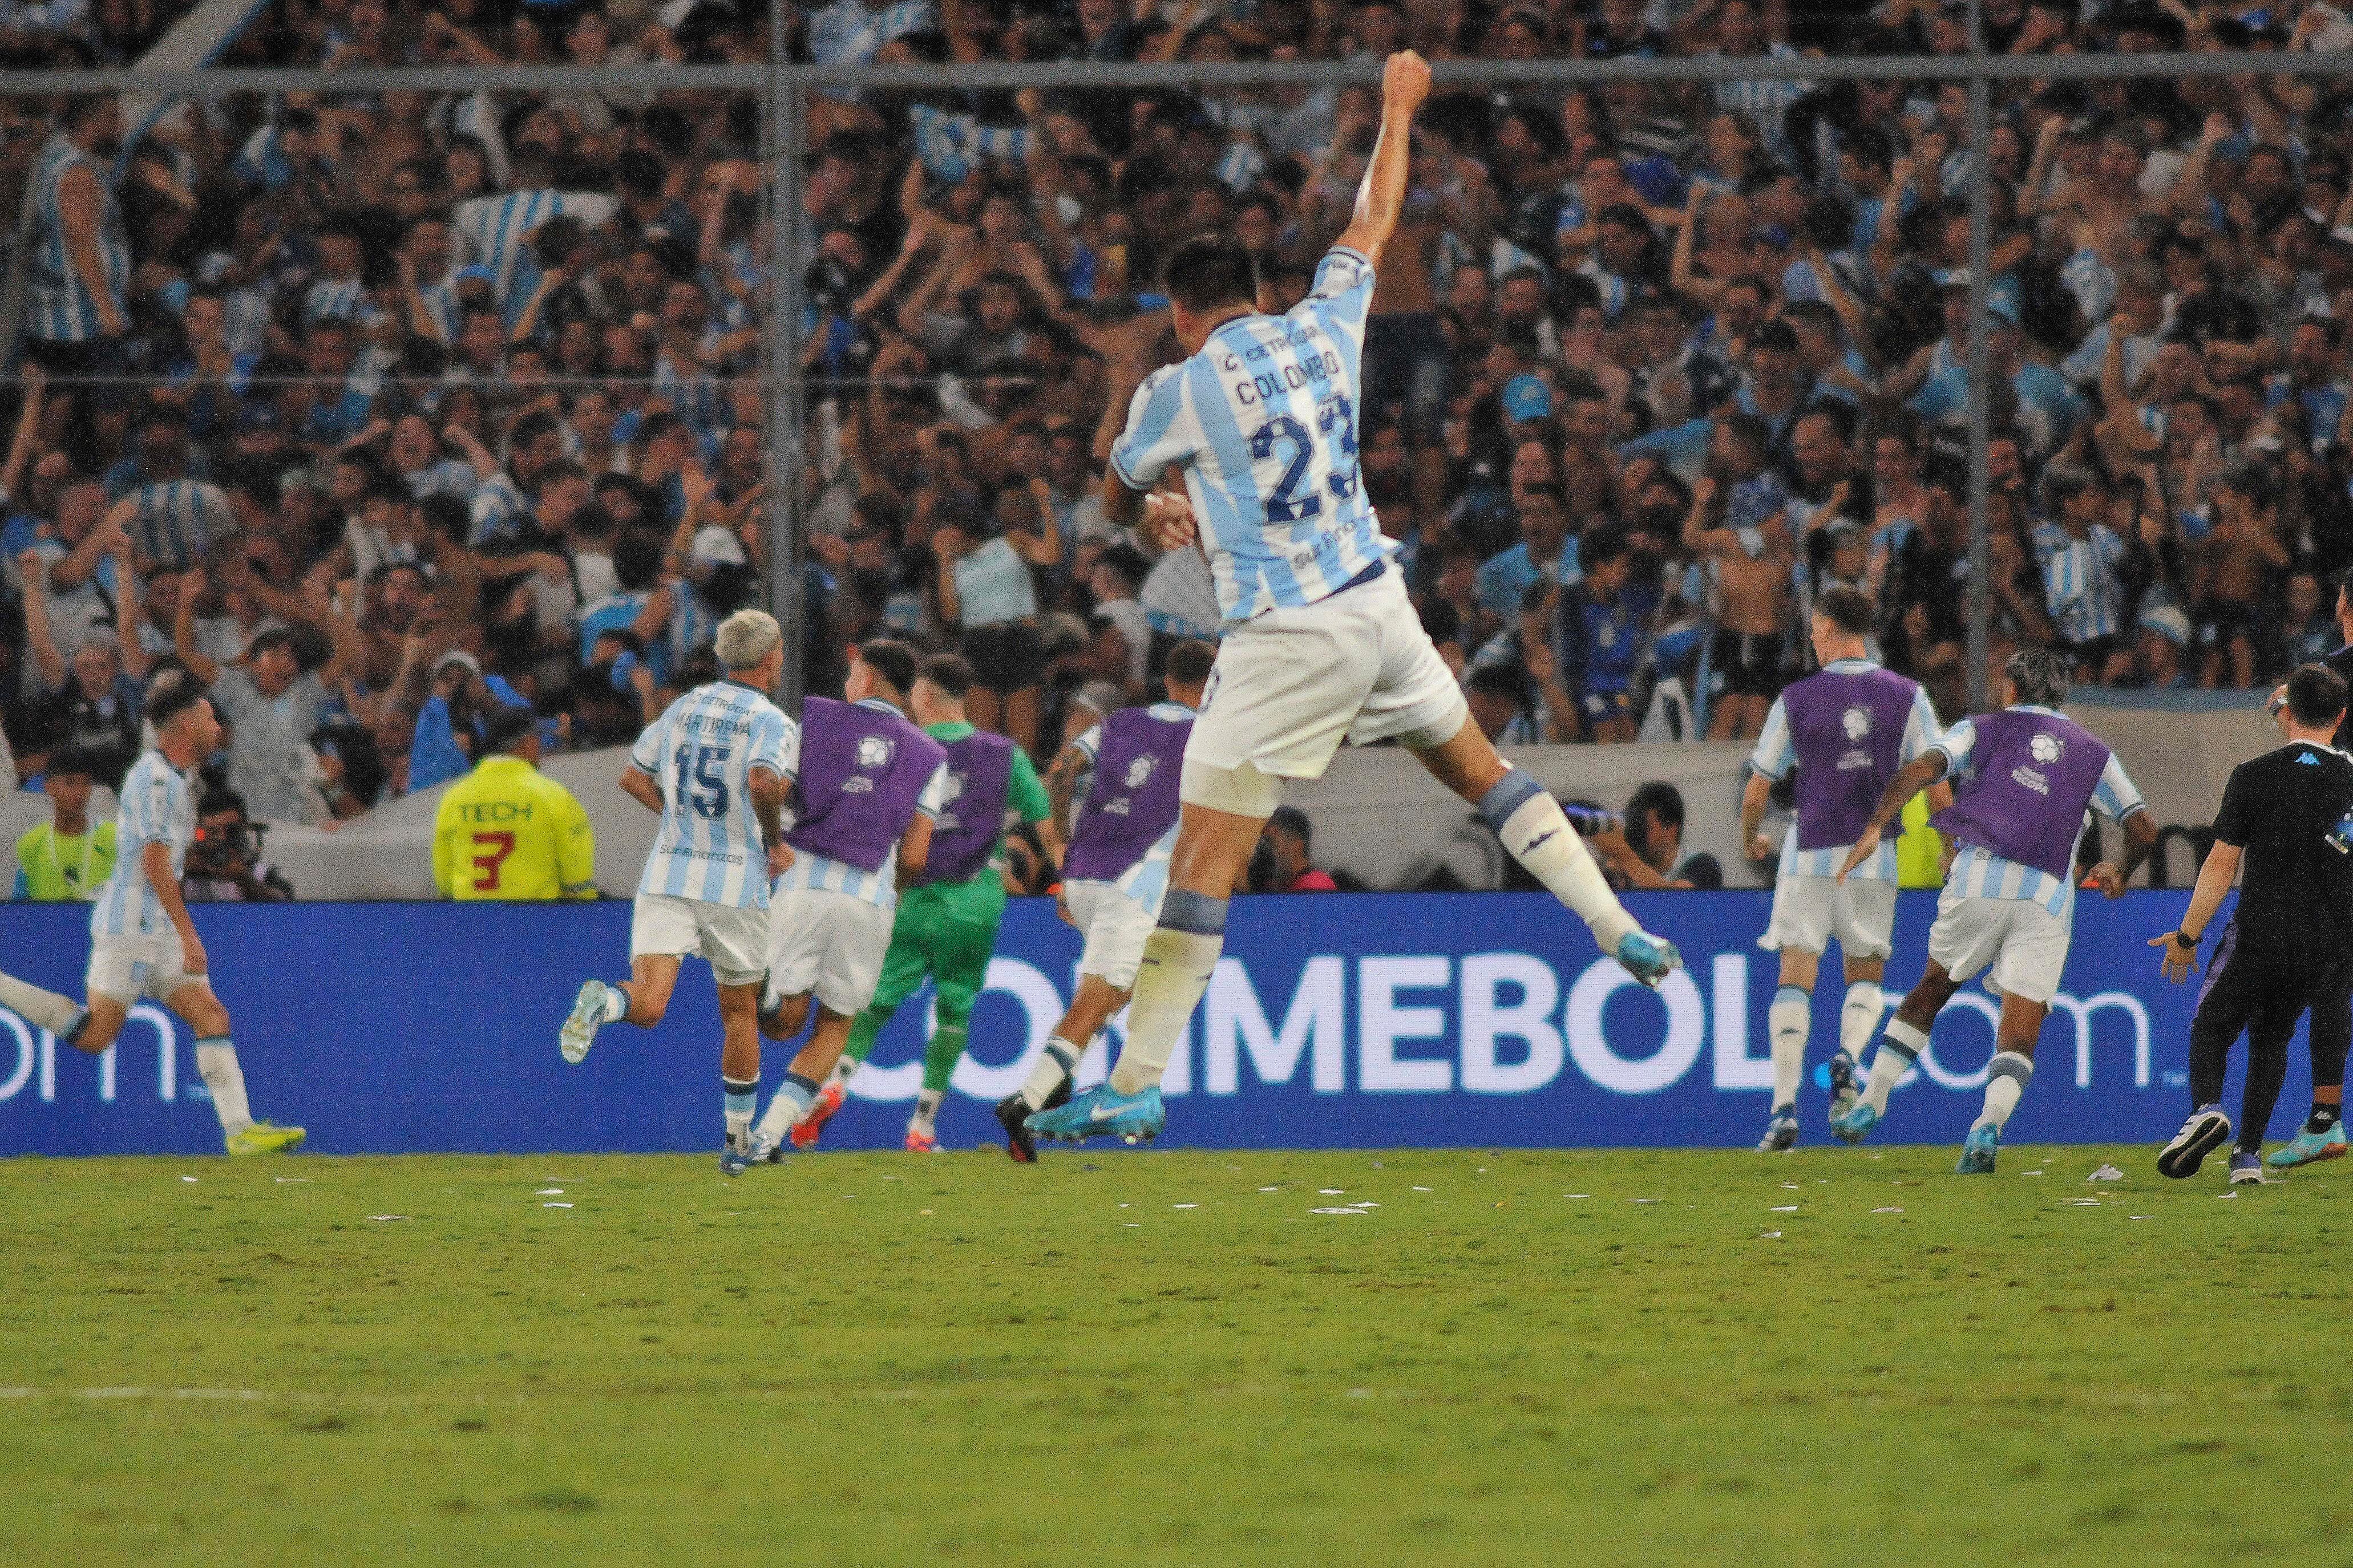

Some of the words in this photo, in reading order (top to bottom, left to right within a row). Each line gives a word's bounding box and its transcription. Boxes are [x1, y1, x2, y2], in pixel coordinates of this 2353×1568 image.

[1236, 350, 1340, 406] COLOMBO
[1248, 392, 1360, 525] 23
[701, 695, 756, 717] CETROGA
[675, 744, 733, 821] 15
[459, 801, 532, 822] TECH
